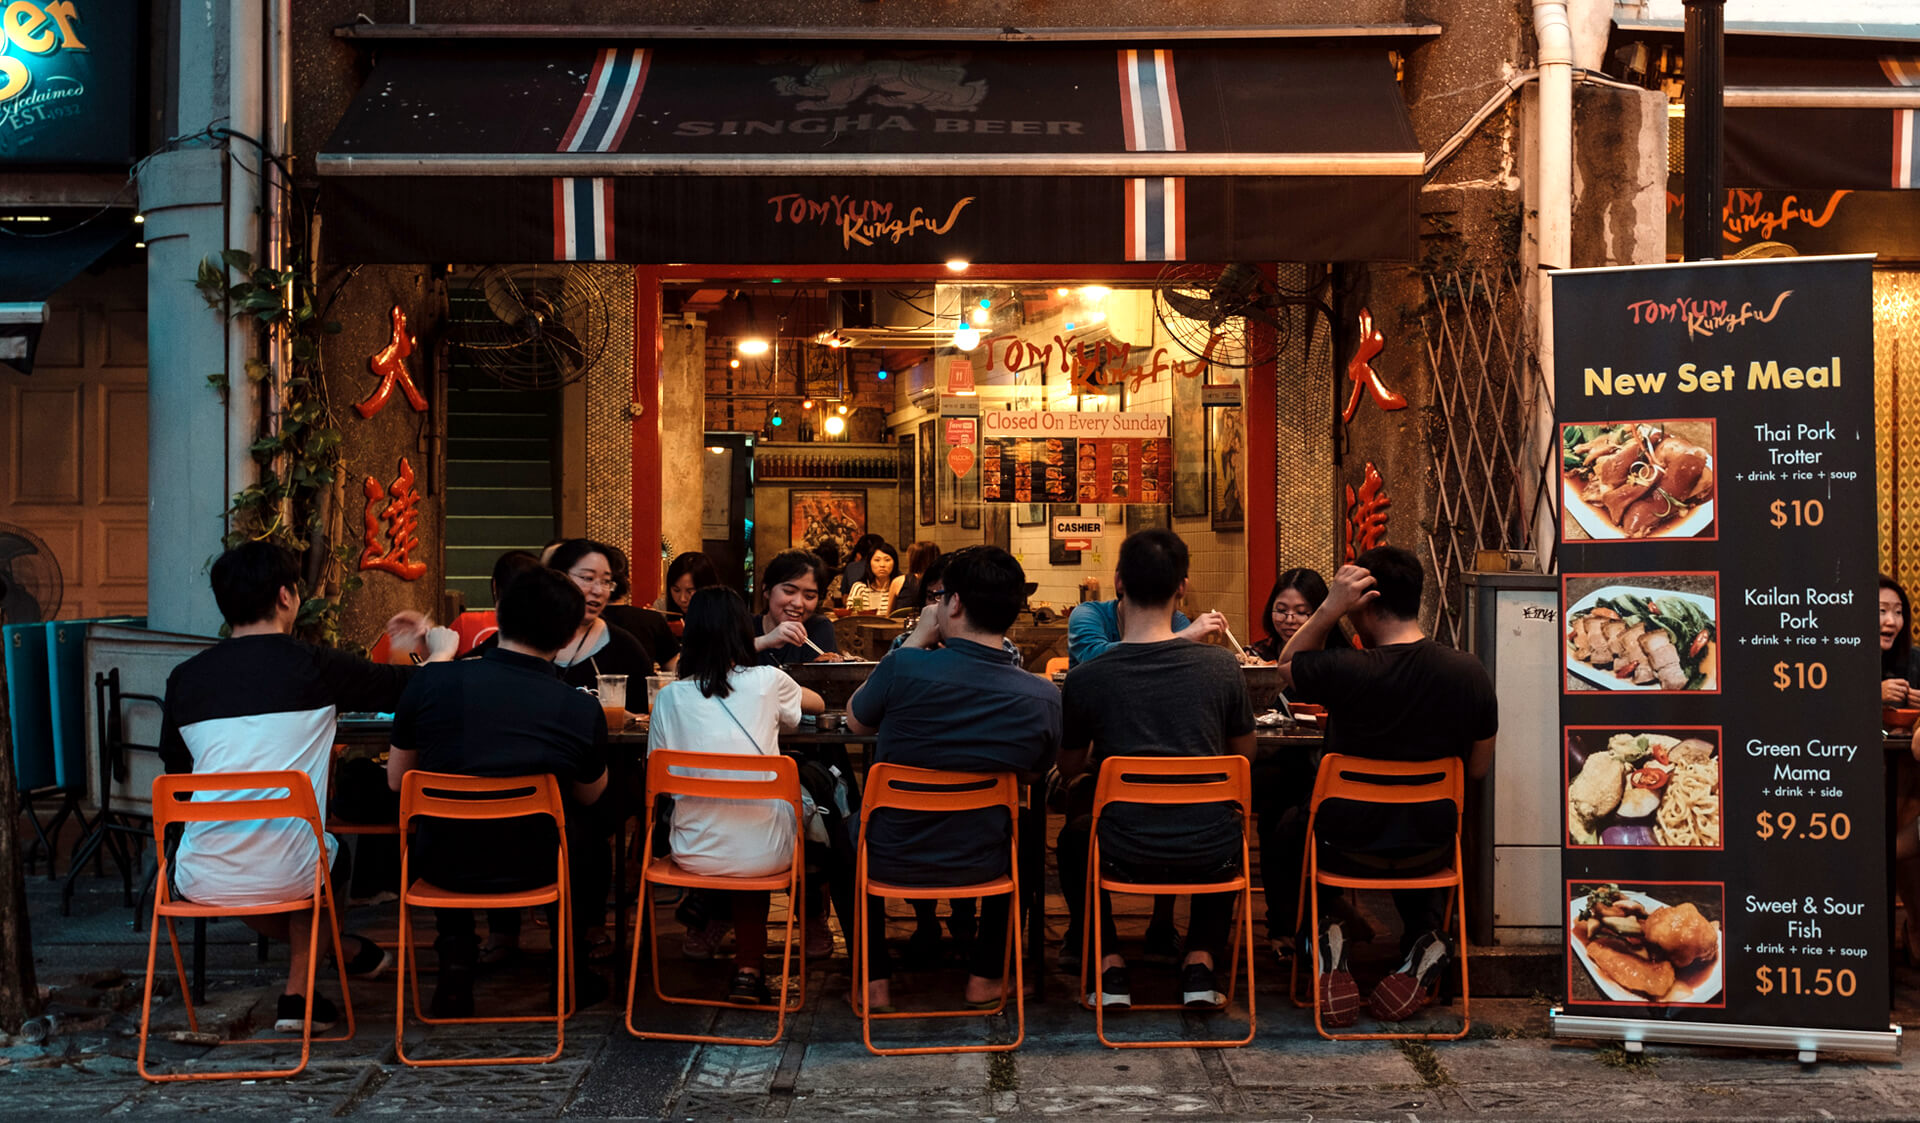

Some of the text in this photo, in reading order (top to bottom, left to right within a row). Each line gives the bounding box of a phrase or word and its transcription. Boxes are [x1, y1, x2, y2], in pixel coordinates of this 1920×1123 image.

[672, 114, 1085, 137] SINGHA BEER
[1584, 356, 1842, 396] New Set Meal
[986, 412, 1167, 435] Closed On Every Sunday
[1753, 420, 1836, 442] Thai Pork
[1768, 447, 1823, 465] Trotter
[1747, 470, 1776, 482] drink
[1792, 469, 1814, 480] rice
[1830, 469, 1857, 482] soup
[1769, 497, 1825, 529] $10
[1057, 523, 1101, 533] CASHIER
[1744, 586, 1854, 606] Kailan Roast
[1779, 610, 1819, 629] Pork
[1750, 634, 1780, 645] drink
[1796, 634, 1817, 645] rice
[1833, 635, 1861, 647] soup
[1773, 660, 1828, 692] $10
[1746, 738, 1858, 762] Green Curry
[1773, 763, 1831, 781] Mama
[1774, 785, 1803, 797] drink
[1820, 786, 1843, 798] side
[1756, 809, 1851, 841] $9.50
[1745, 894, 1798, 914] Sweet
[1823, 896, 1865, 916] Sour
[1788, 919, 1822, 939] Fish
[1756, 942, 1785, 954] drink
[1802, 944, 1823, 955] rice
[1840, 947, 1868, 958] soup
[1755, 964, 1857, 997] $11.50
